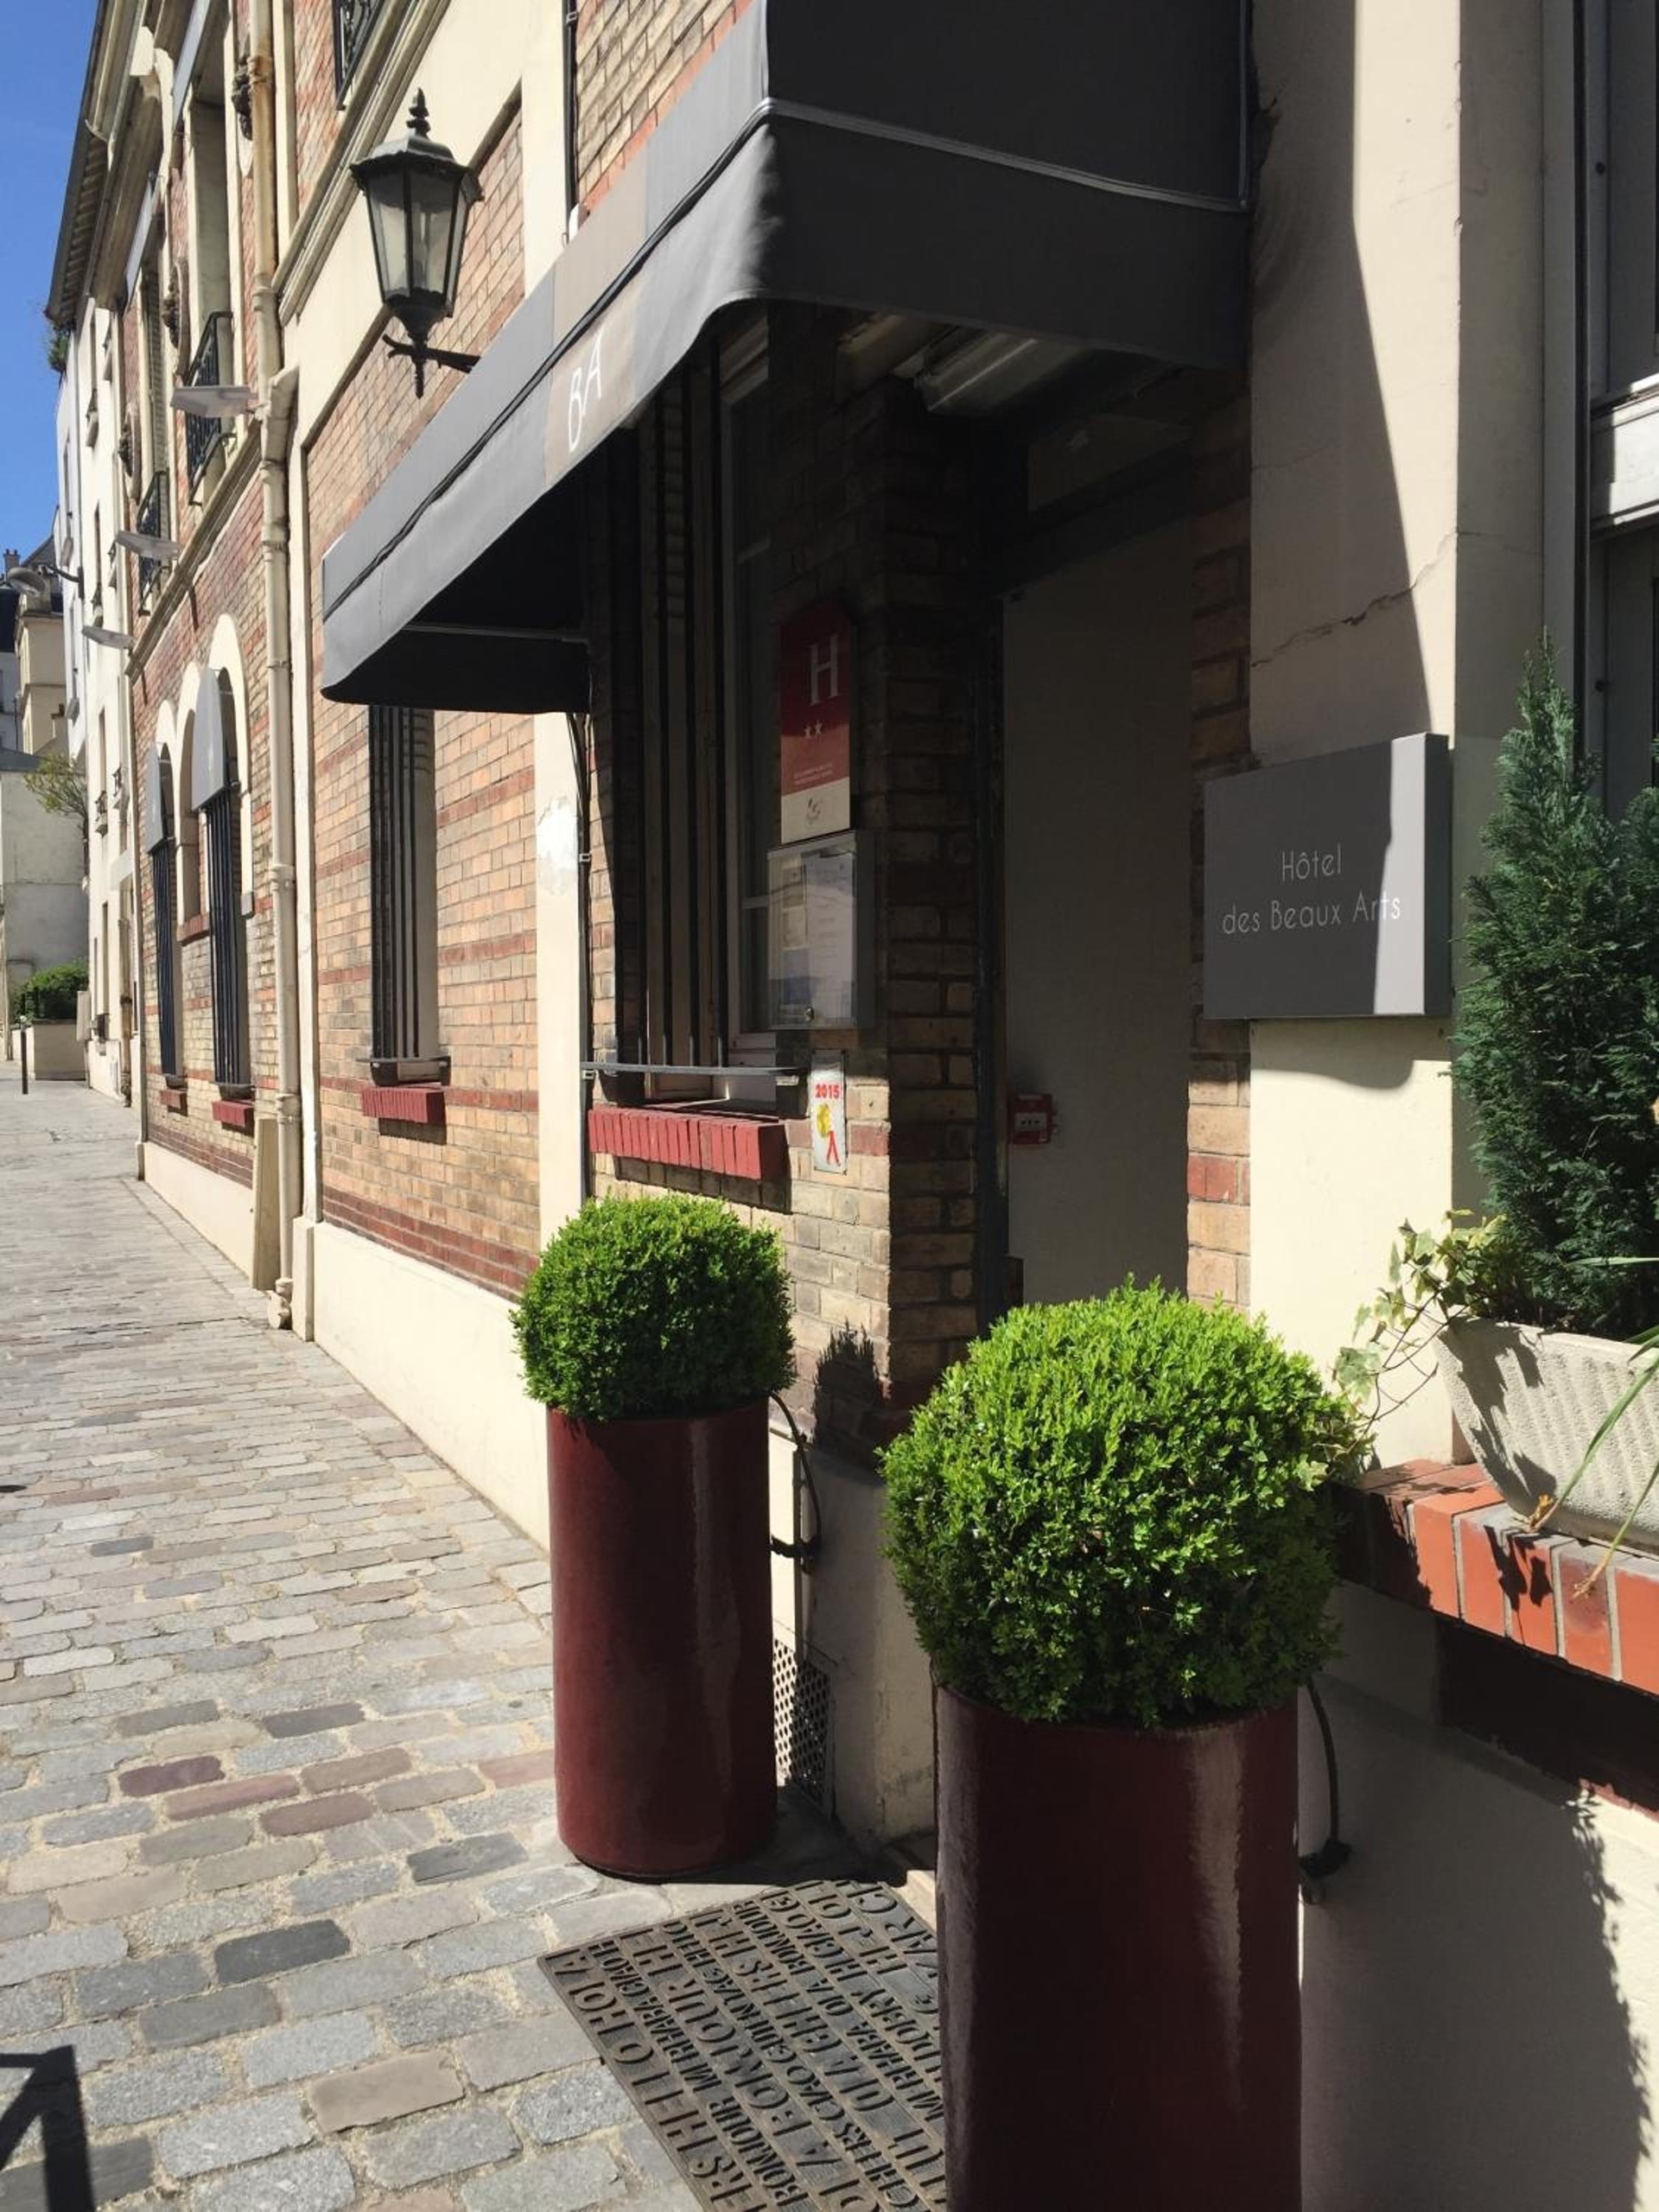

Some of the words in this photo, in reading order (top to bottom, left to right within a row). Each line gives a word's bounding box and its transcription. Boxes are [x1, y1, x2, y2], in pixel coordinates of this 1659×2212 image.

[569, 327, 603, 452] BA
[809, 633, 839, 707] H
[1281, 843, 1342, 882] Hôtel
[1222, 904, 1261, 934] des
[1270, 899, 1342, 931] Beaux
[1352, 890, 1401, 922] Arts
[815, 1084, 840, 1099] 2015
